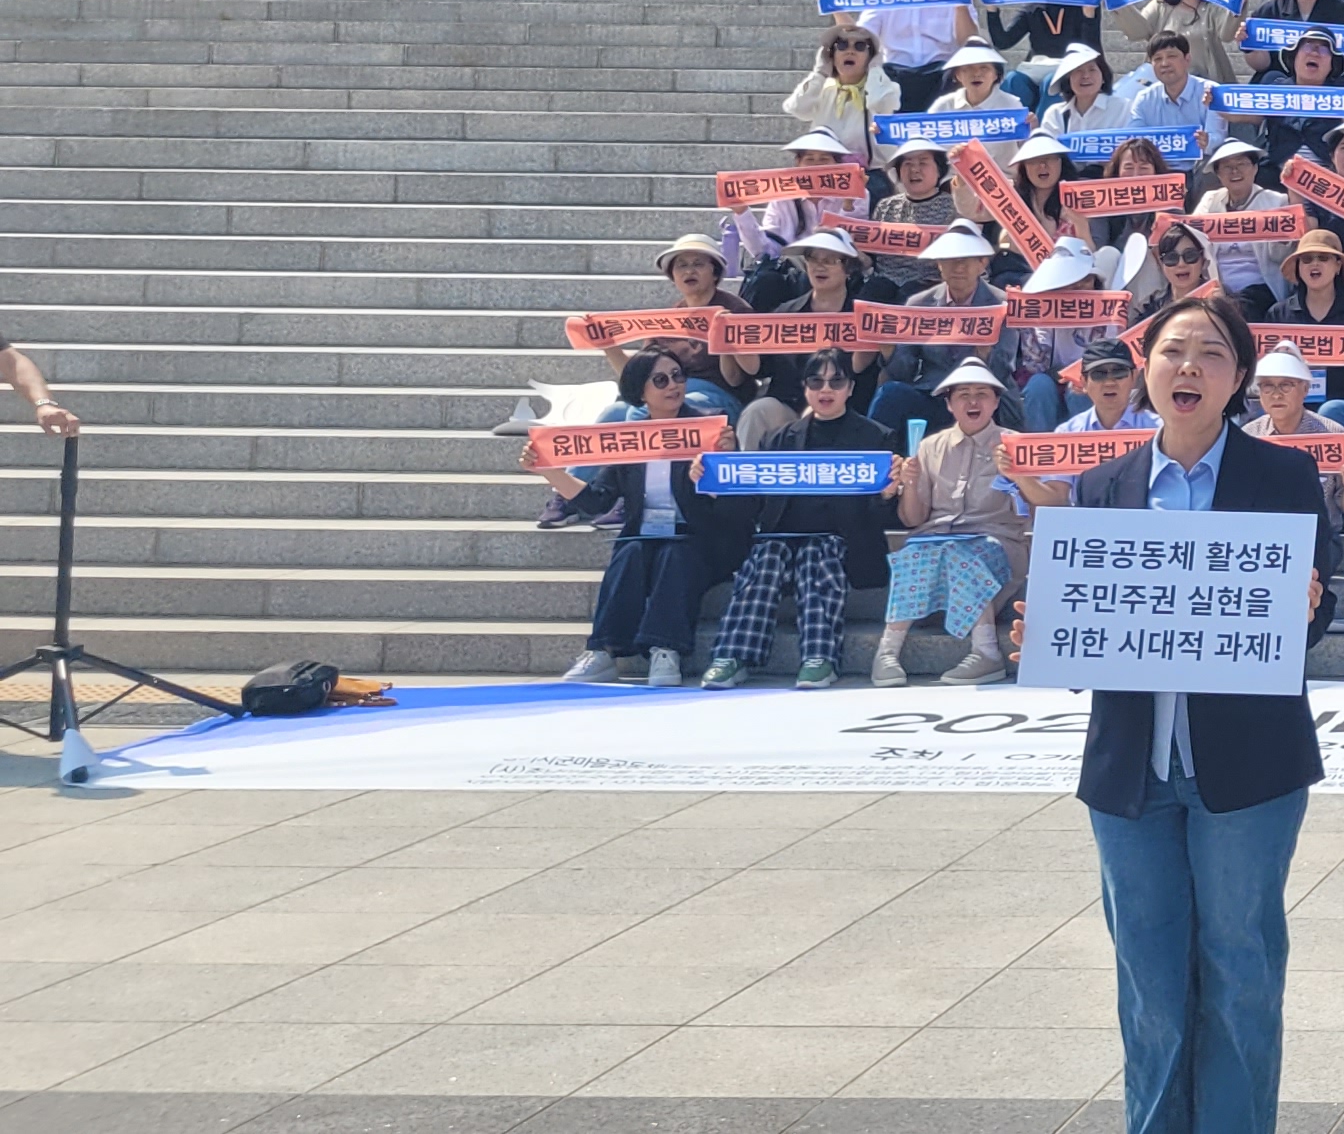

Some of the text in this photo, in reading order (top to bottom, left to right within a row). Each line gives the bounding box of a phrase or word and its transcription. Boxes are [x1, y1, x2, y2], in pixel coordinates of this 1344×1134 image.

[890, 117, 1017, 139] 마을공동체활성화
[724, 172, 851, 199] 마을기본법 제정
[1063, 183, 1185, 210] 마을기본법 제정
[1007, 297, 1095, 319] 마을기본법
[586, 315, 674, 342] 마을기본법
[725, 324, 817, 345] 마을기본법
[862, 312, 993, 336] 마을기본법 제정
[1016, 443, 1116, 467] 마을기본법
[717, 463, 878, 486] 마을공동체활성화
[1052, 538, 1292, 573] 마을공동체 활성화
[1061, 583, 1273, 618] 주민주권 실현을
[1051, 628, 1282, 663] 위한 시대적 과제!
